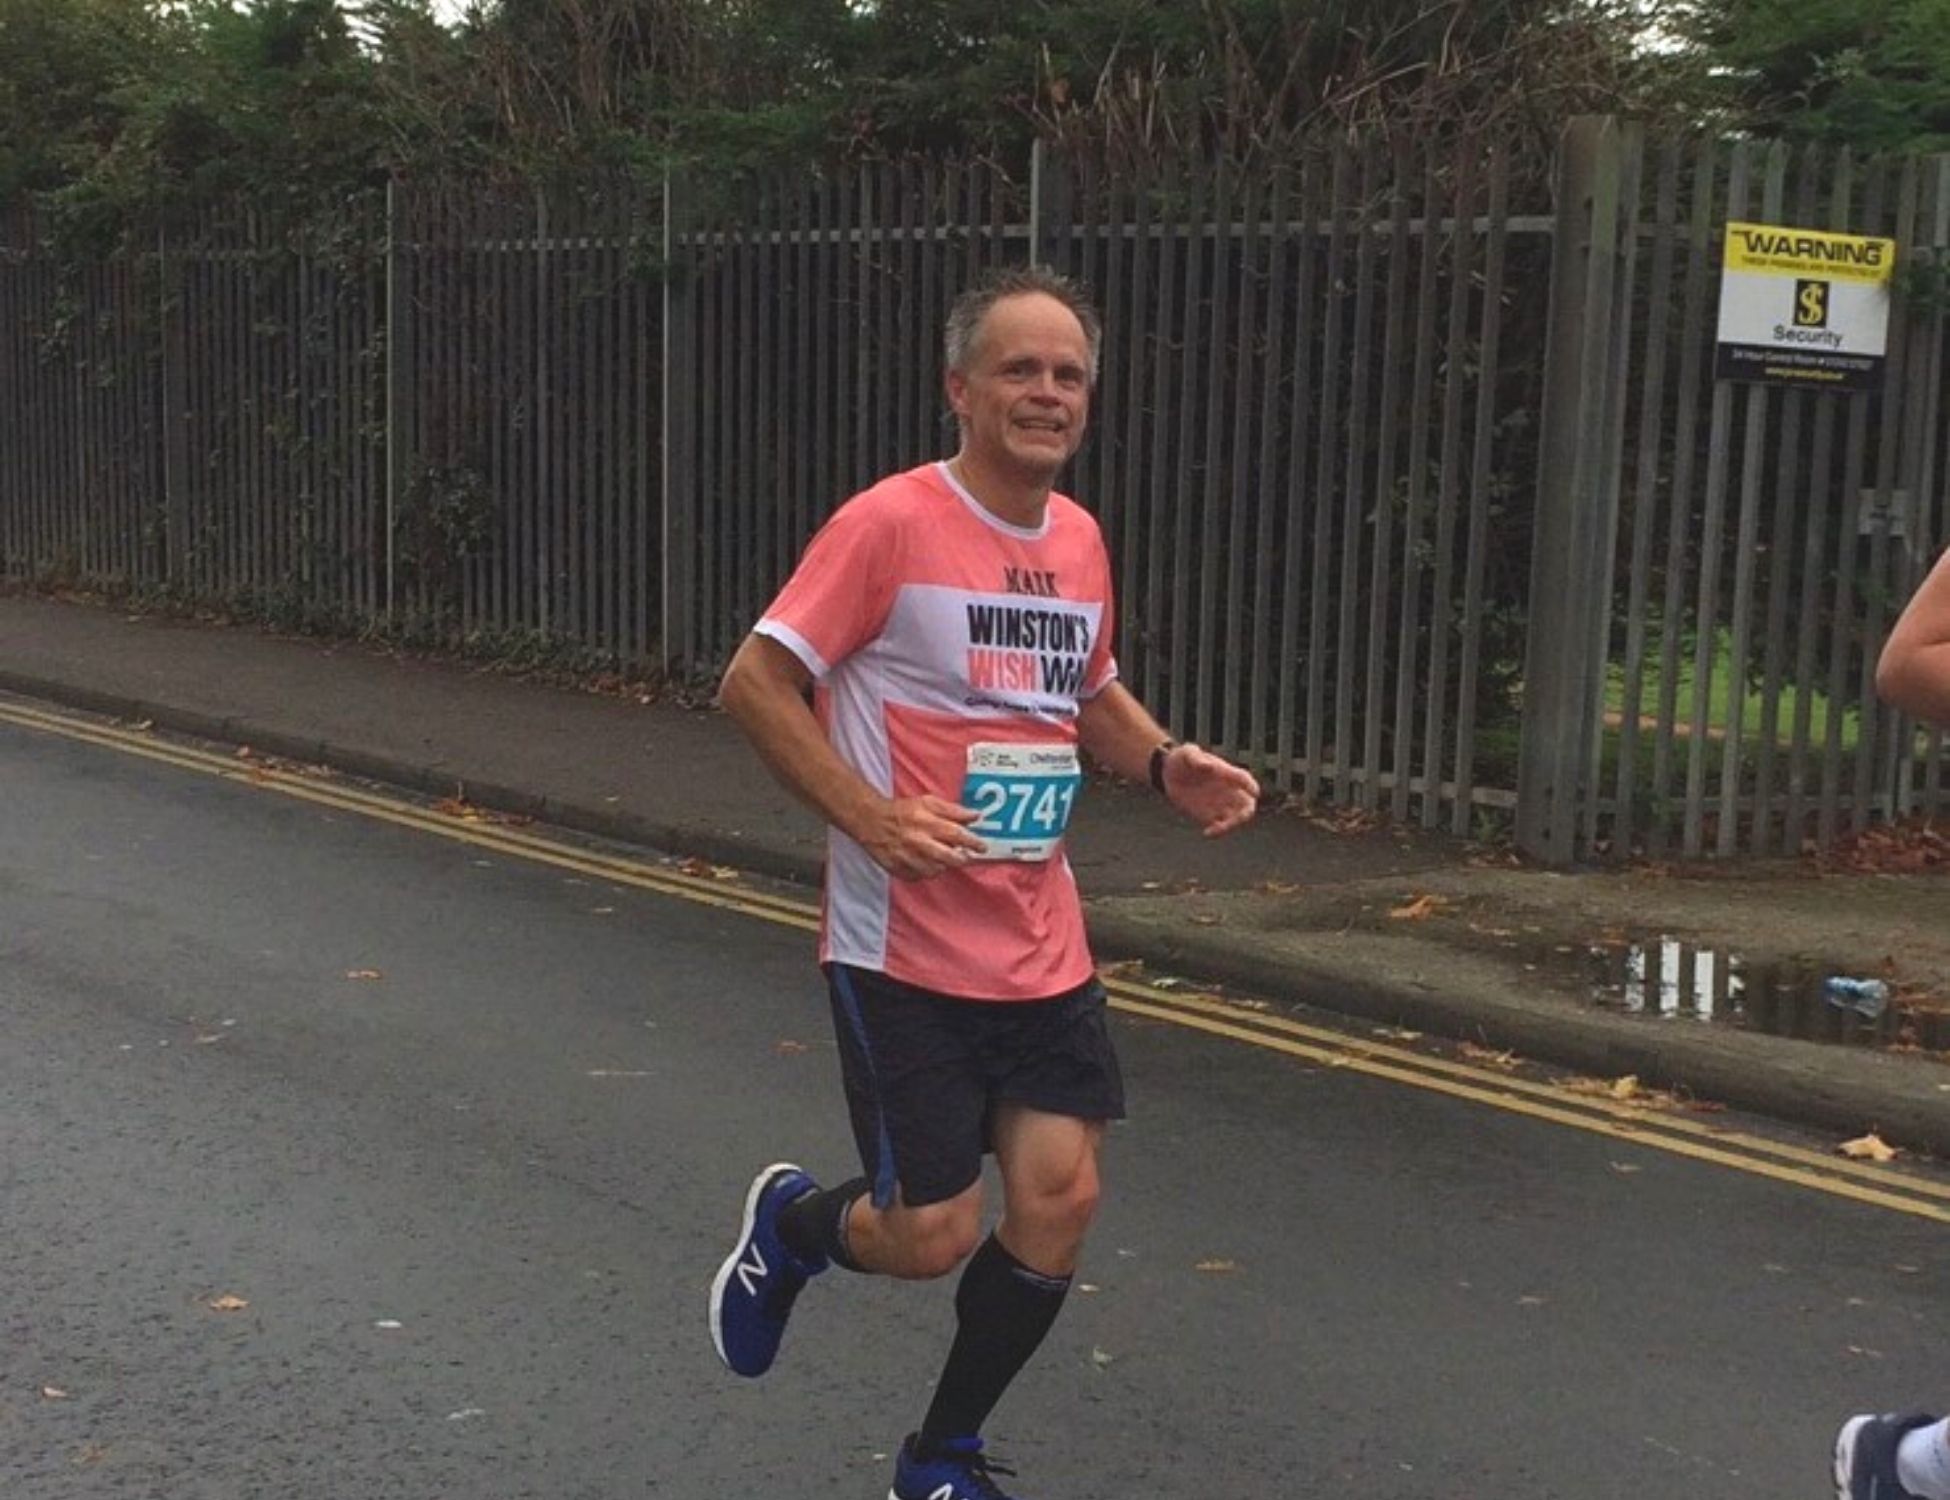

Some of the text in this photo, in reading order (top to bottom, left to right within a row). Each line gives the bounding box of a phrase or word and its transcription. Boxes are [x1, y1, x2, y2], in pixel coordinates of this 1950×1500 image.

[1732, 230, 1884, 266] WARNING
[1773, 324, 1843, 348] Security
[967, 603, 1089, 653] WINSTON'S
[967, 648, 1036, 692] WISH
[968, 781, 1075, 832] 2741
